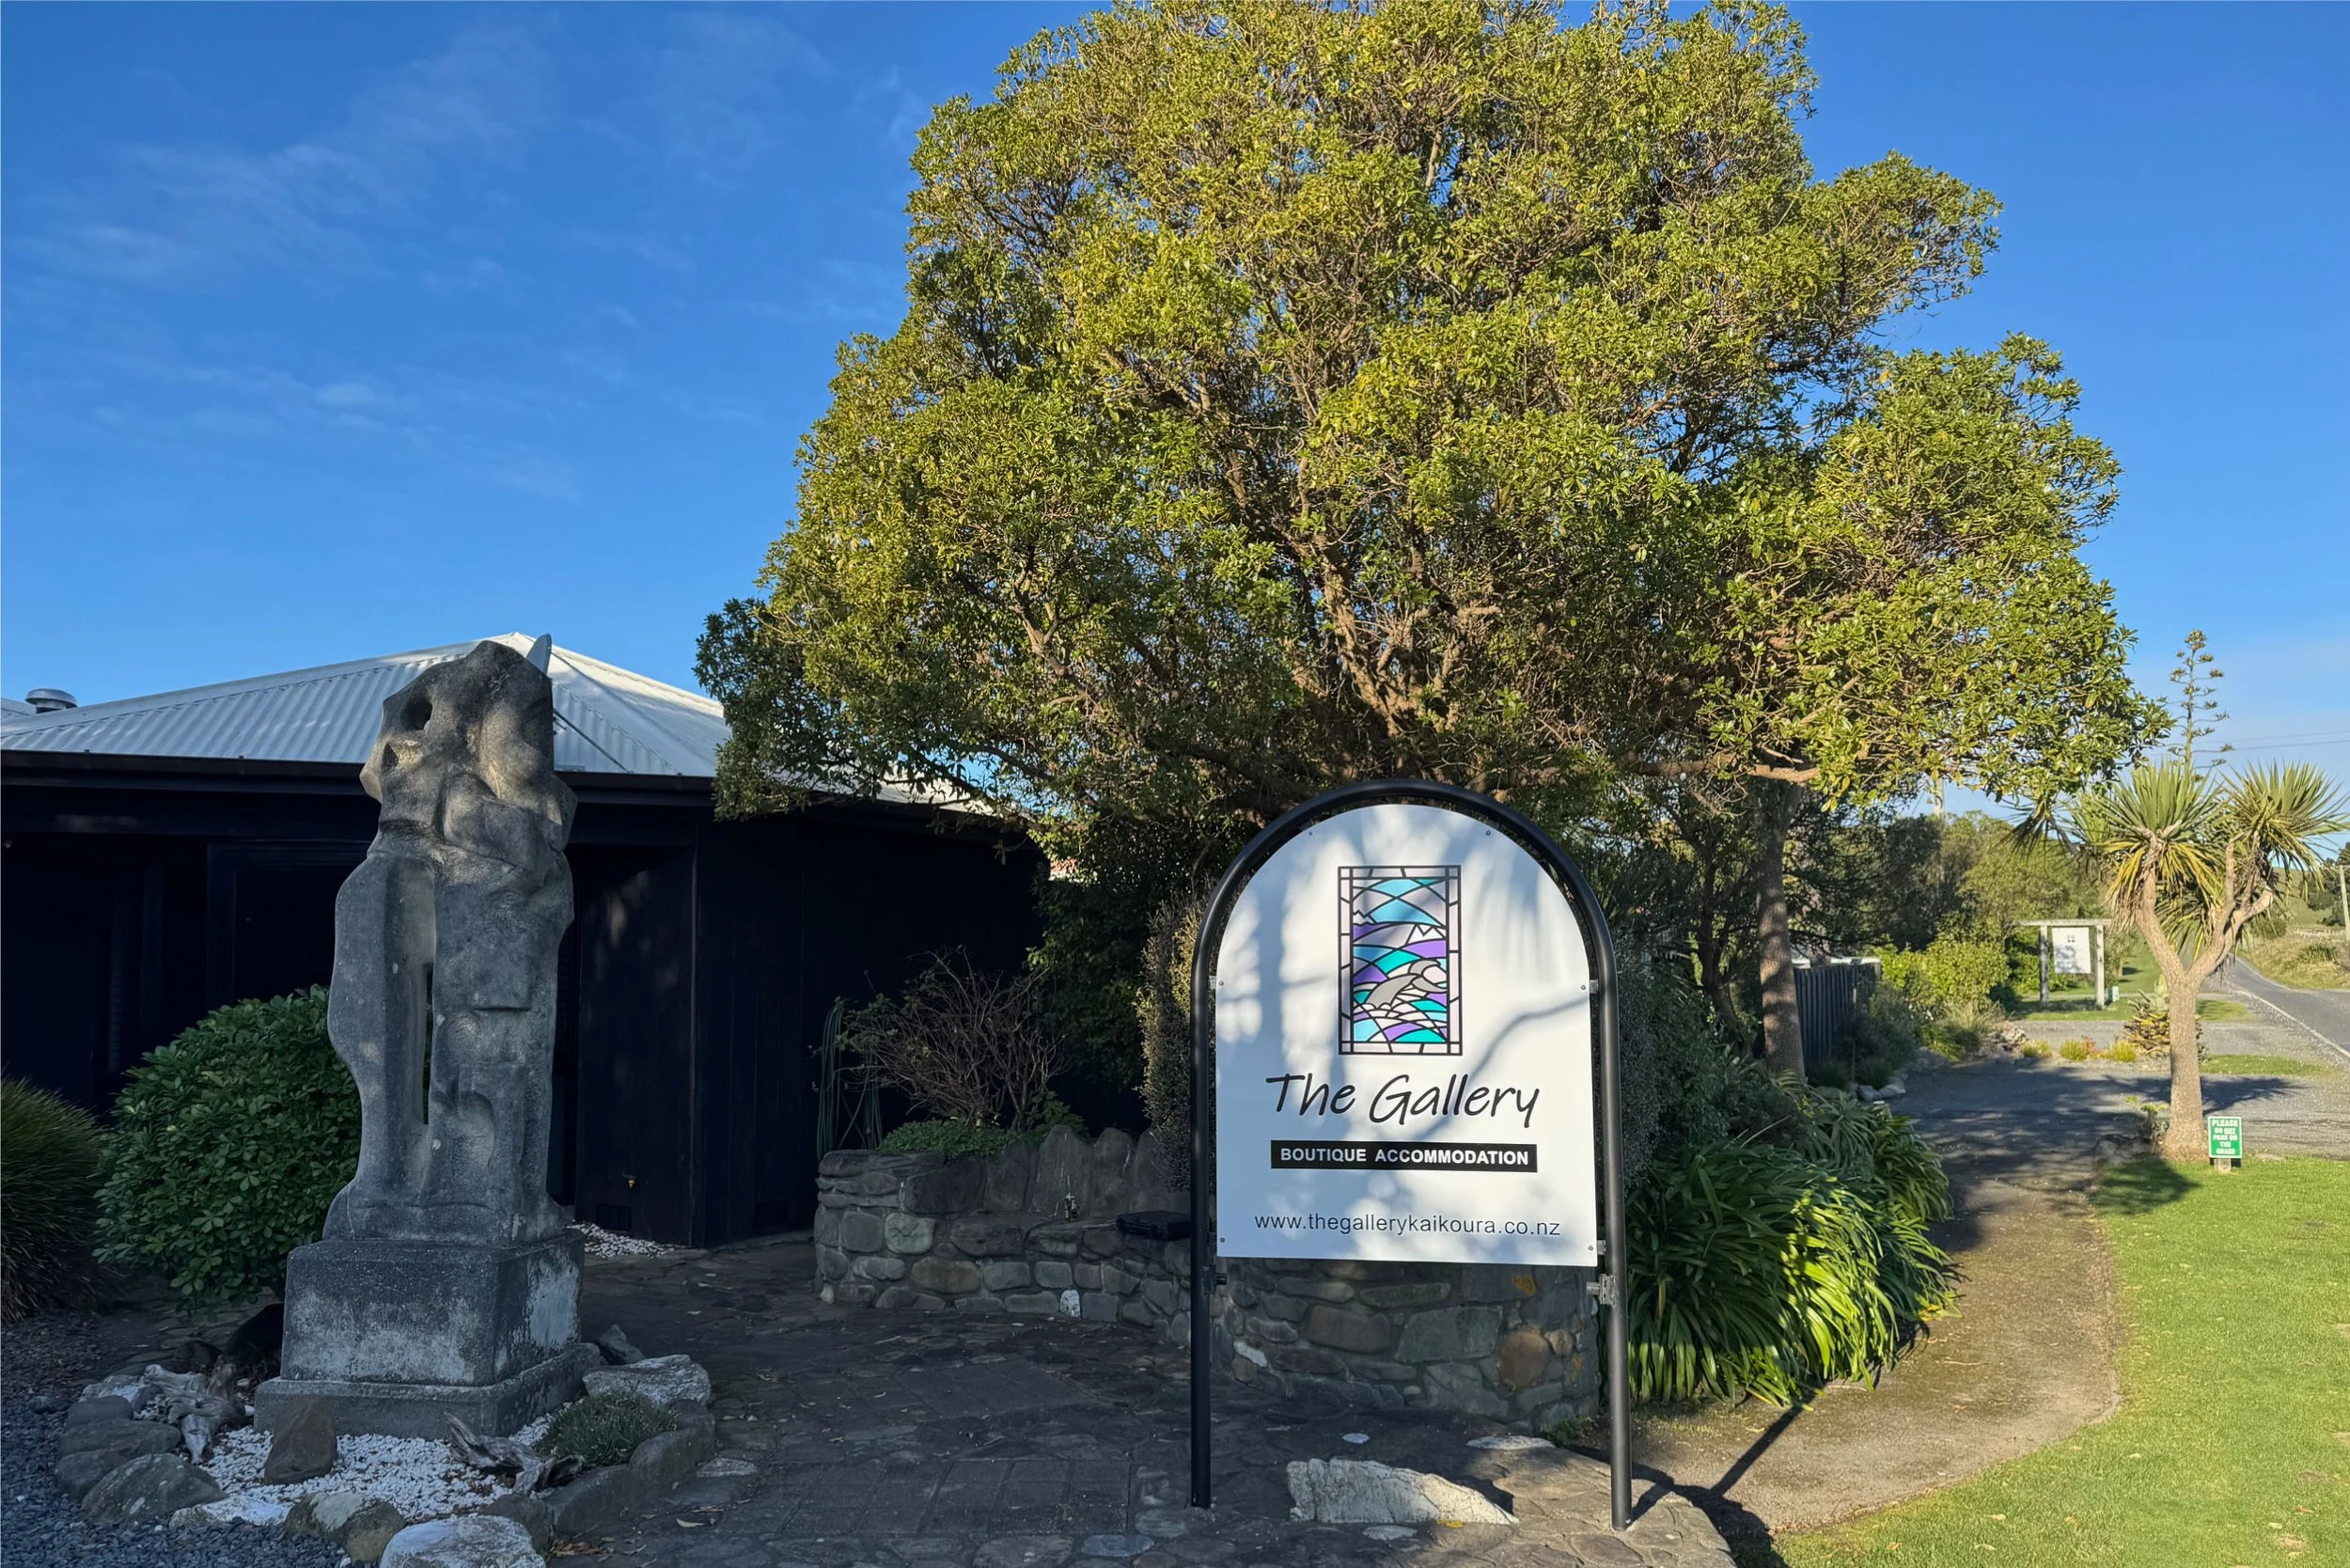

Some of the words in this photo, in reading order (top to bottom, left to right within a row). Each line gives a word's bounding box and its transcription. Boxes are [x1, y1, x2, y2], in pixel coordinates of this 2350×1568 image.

[1265, 1073, 1355, 1117] The
[1369, 1074, 1540, 1128] Gallery
[2212, 1119, 2238, 1127] PLEASE
[1280, 1148, 1367, 1164] BOUTIQUE
[1375, 1149, 1529, 1166] ACCOMMODATION
[1254, 1213, 1560, 1236] www.thegallerykaikoura.co.nz
